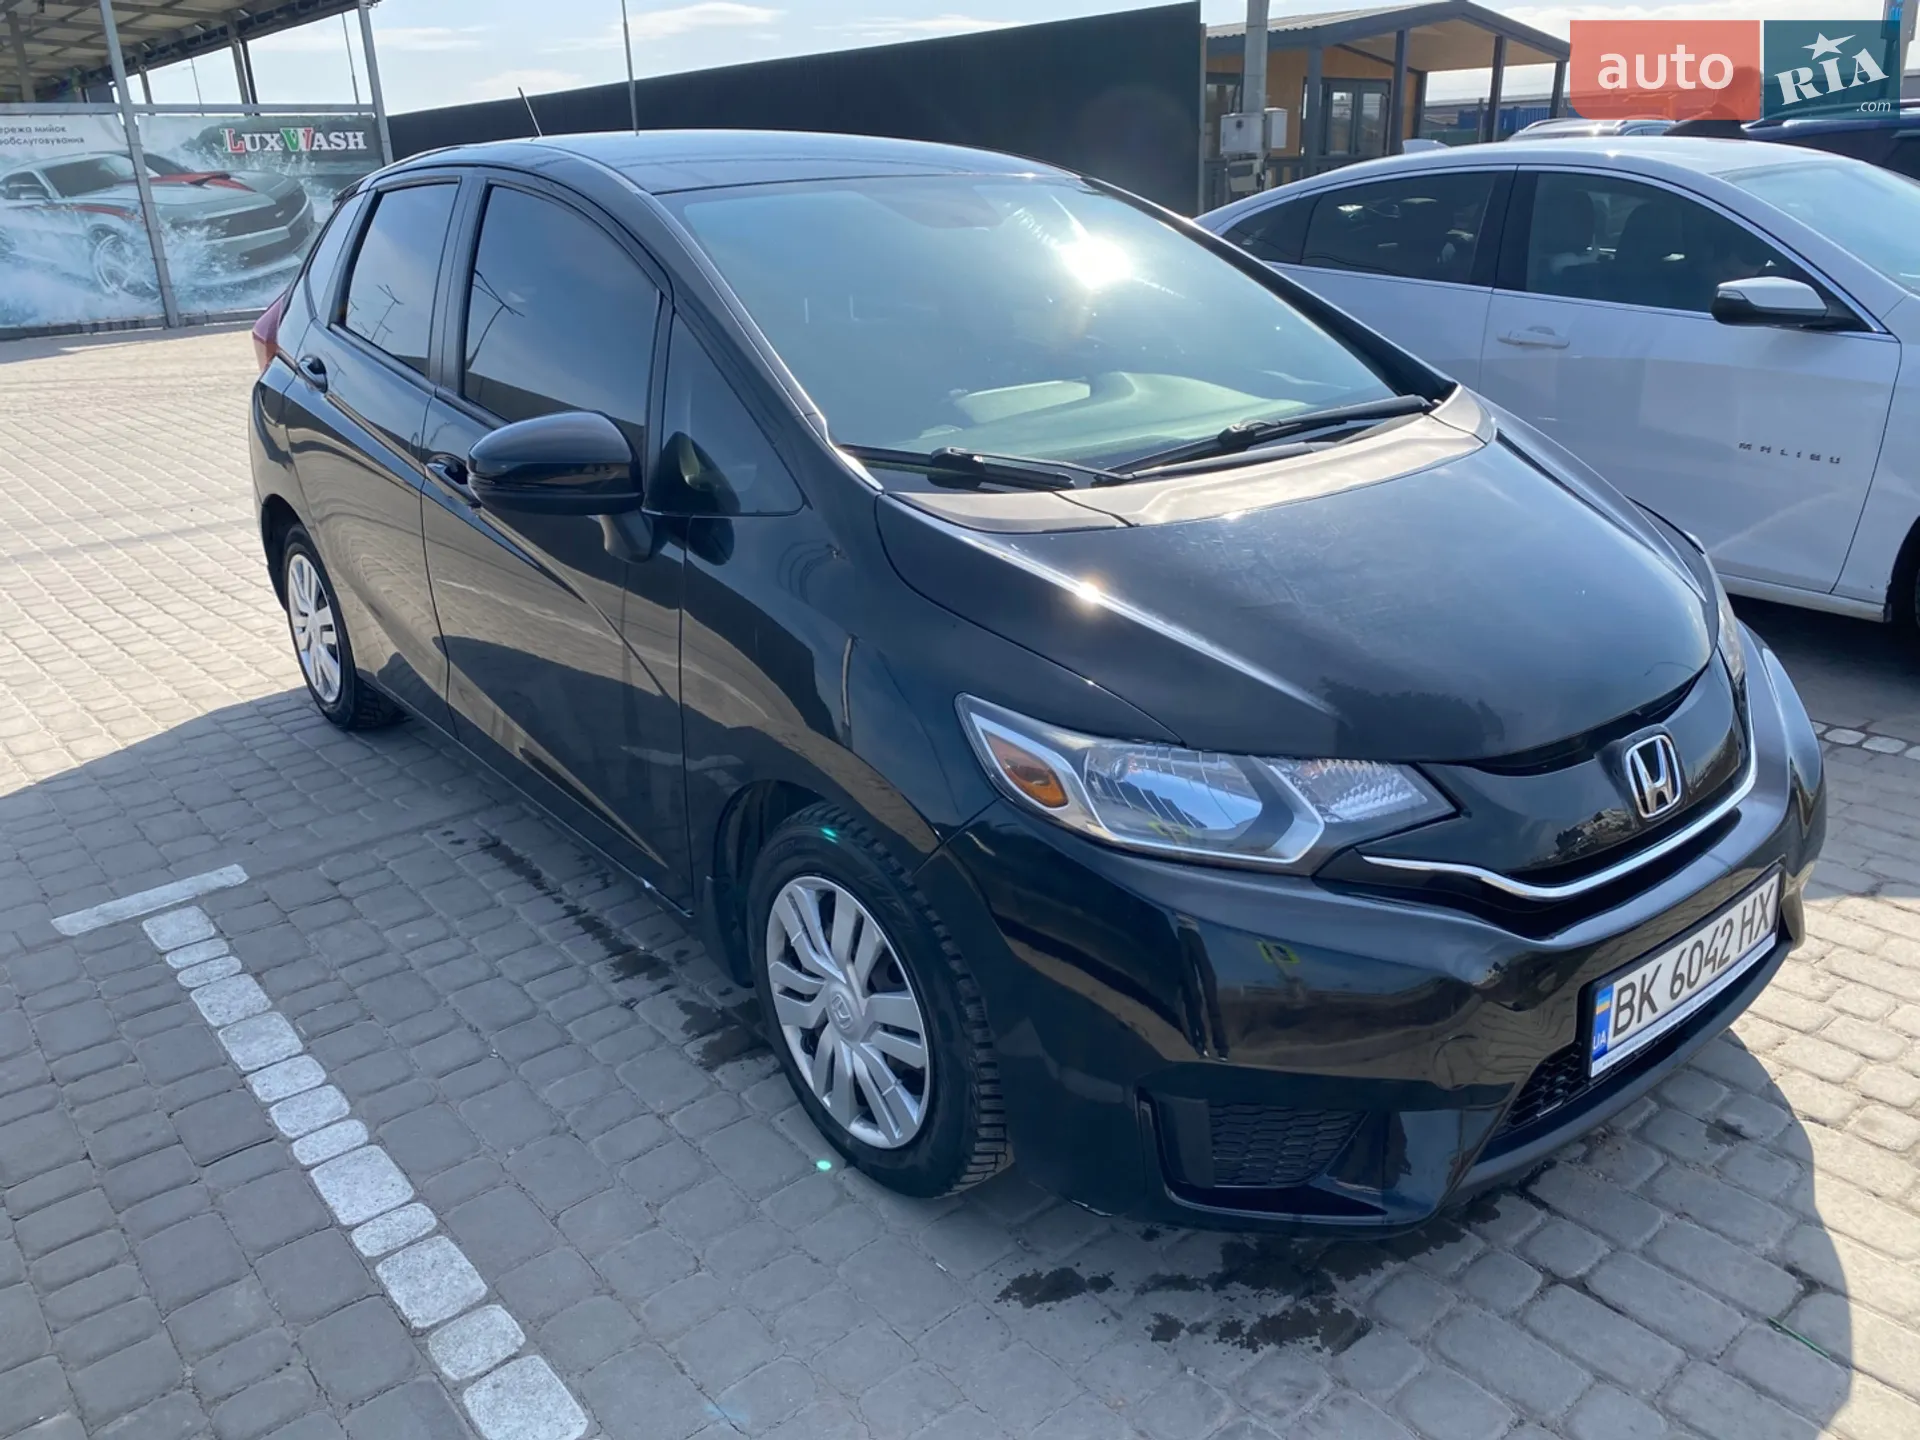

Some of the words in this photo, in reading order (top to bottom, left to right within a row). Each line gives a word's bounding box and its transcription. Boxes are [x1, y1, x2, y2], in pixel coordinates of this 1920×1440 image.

[219, 127, 367, 154] LUXWASH
[1738, 441, 1841, 464] MALIBU
[1612, 963, 1662, 1039] BK
[1669, 920, 1734, 1001] 6042
[1737, 883, 1775, 953] HX
[1592, 1031, 1608, 1050] UA
